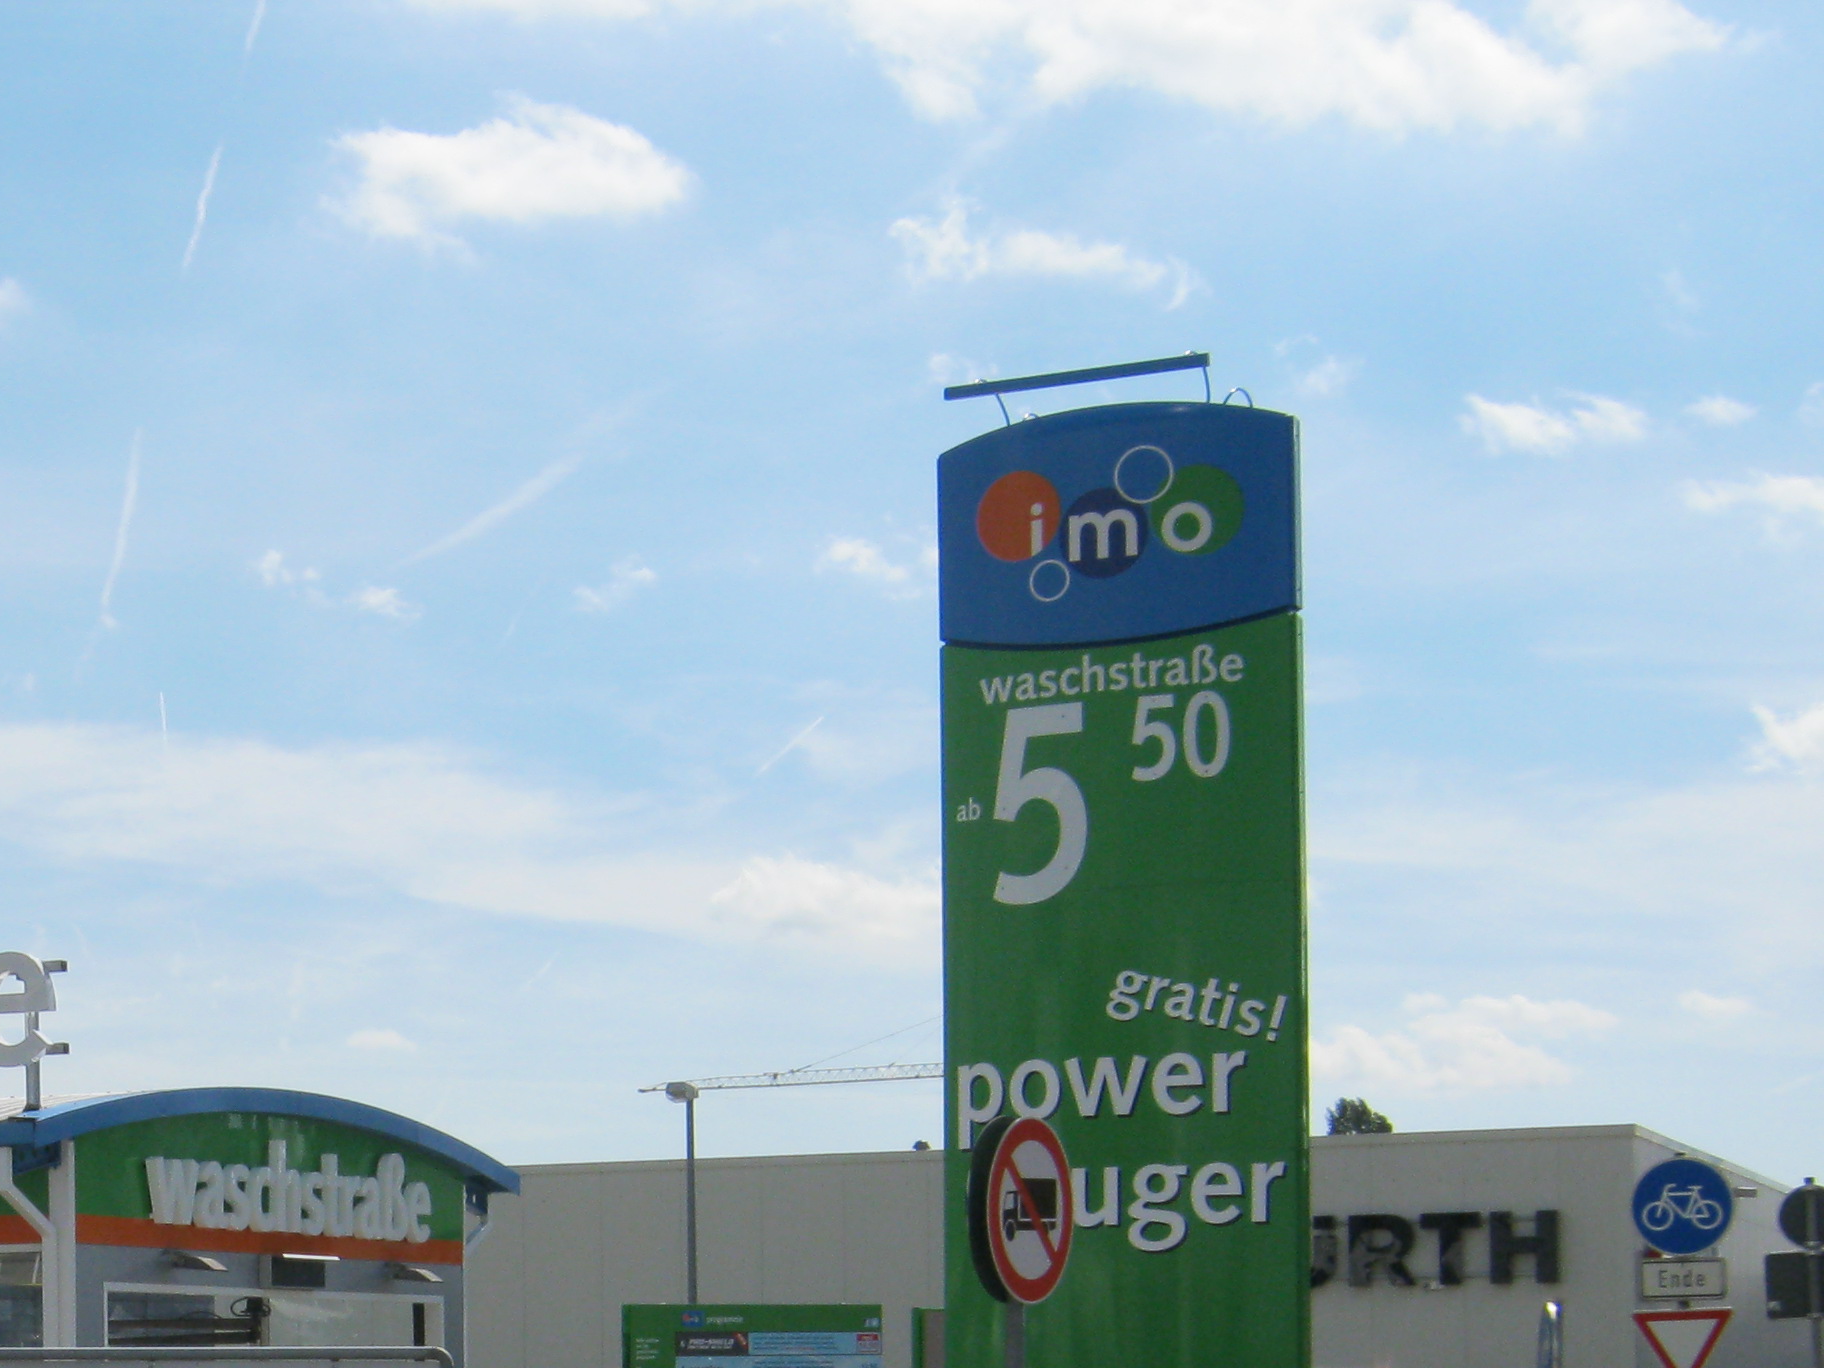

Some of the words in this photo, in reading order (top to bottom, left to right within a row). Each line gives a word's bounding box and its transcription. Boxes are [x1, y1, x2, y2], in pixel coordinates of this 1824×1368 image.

[1029, 502, 1214, 561] imo
[979, 643, 1245, 705] waschstraße
[956, 797, 982, 823] ab
[993, 702, 1088, 906] 5
[1131, 690, 1231, 781] 50
[1106, 970, 1287, 1042] gratis!
[957, 1050, 1248, 1150] power
[145, 1140, 433, 1243] waschstraße
[966, 1160, 1287, 1252] uger
[1658, 1269, 1705, 1288] Ende
